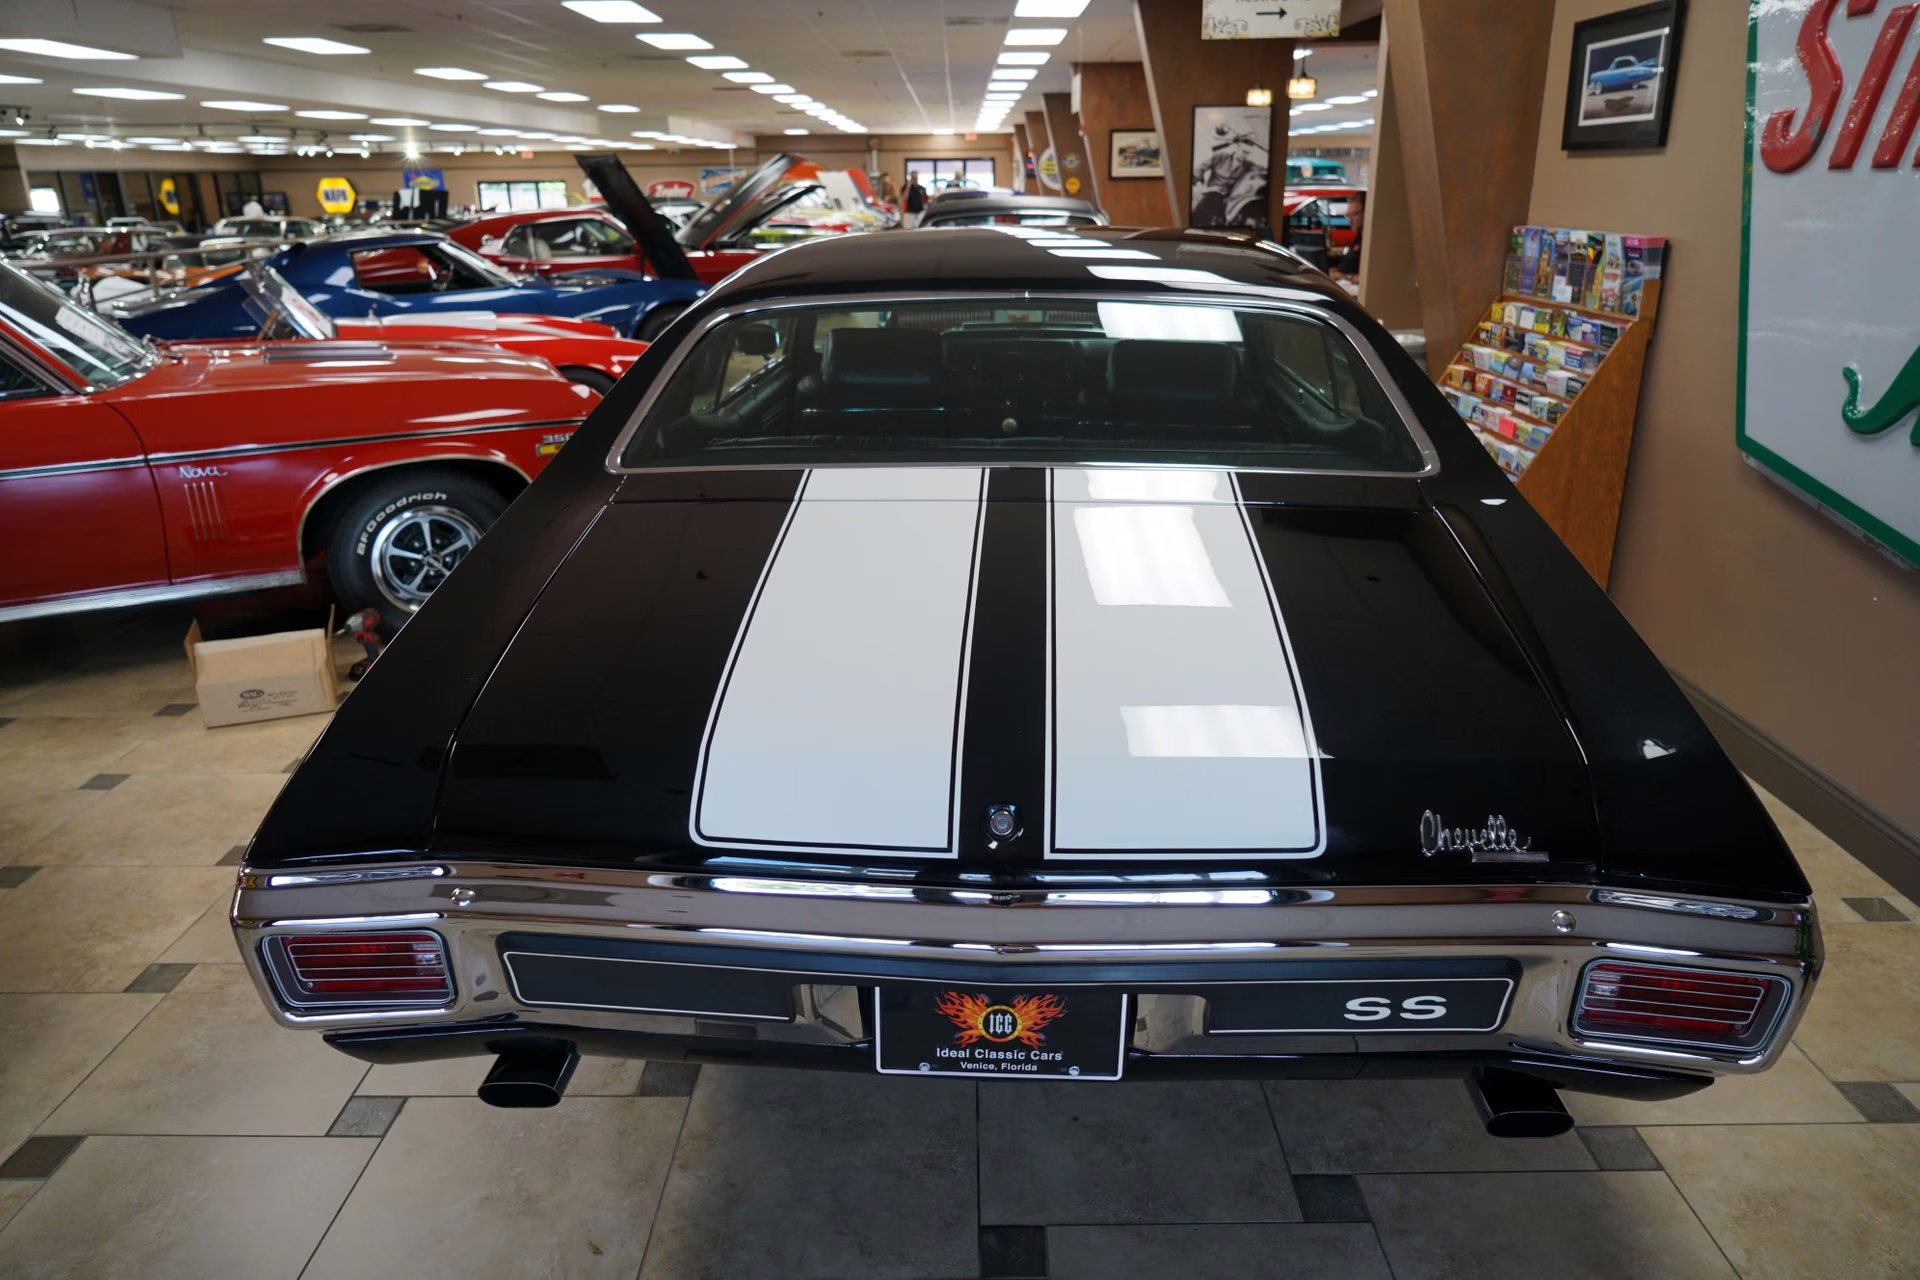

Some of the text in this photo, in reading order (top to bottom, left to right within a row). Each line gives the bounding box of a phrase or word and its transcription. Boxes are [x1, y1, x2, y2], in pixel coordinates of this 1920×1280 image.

[323, 189, 348, 202] NAPA
[179, 465, 228, 479] Nova
[356, 491, 448, 556] BFGoodrich
[1420, 809, 1531, 857] Chevelle
[1343, 995, 1448, 1021] SS
[988, 1012, 1013, 1035] ICC
[936, 1047, 1063, 1062] Ideal Classic Cars
[960, 1061, 1037, 1072] Venice, Florida
